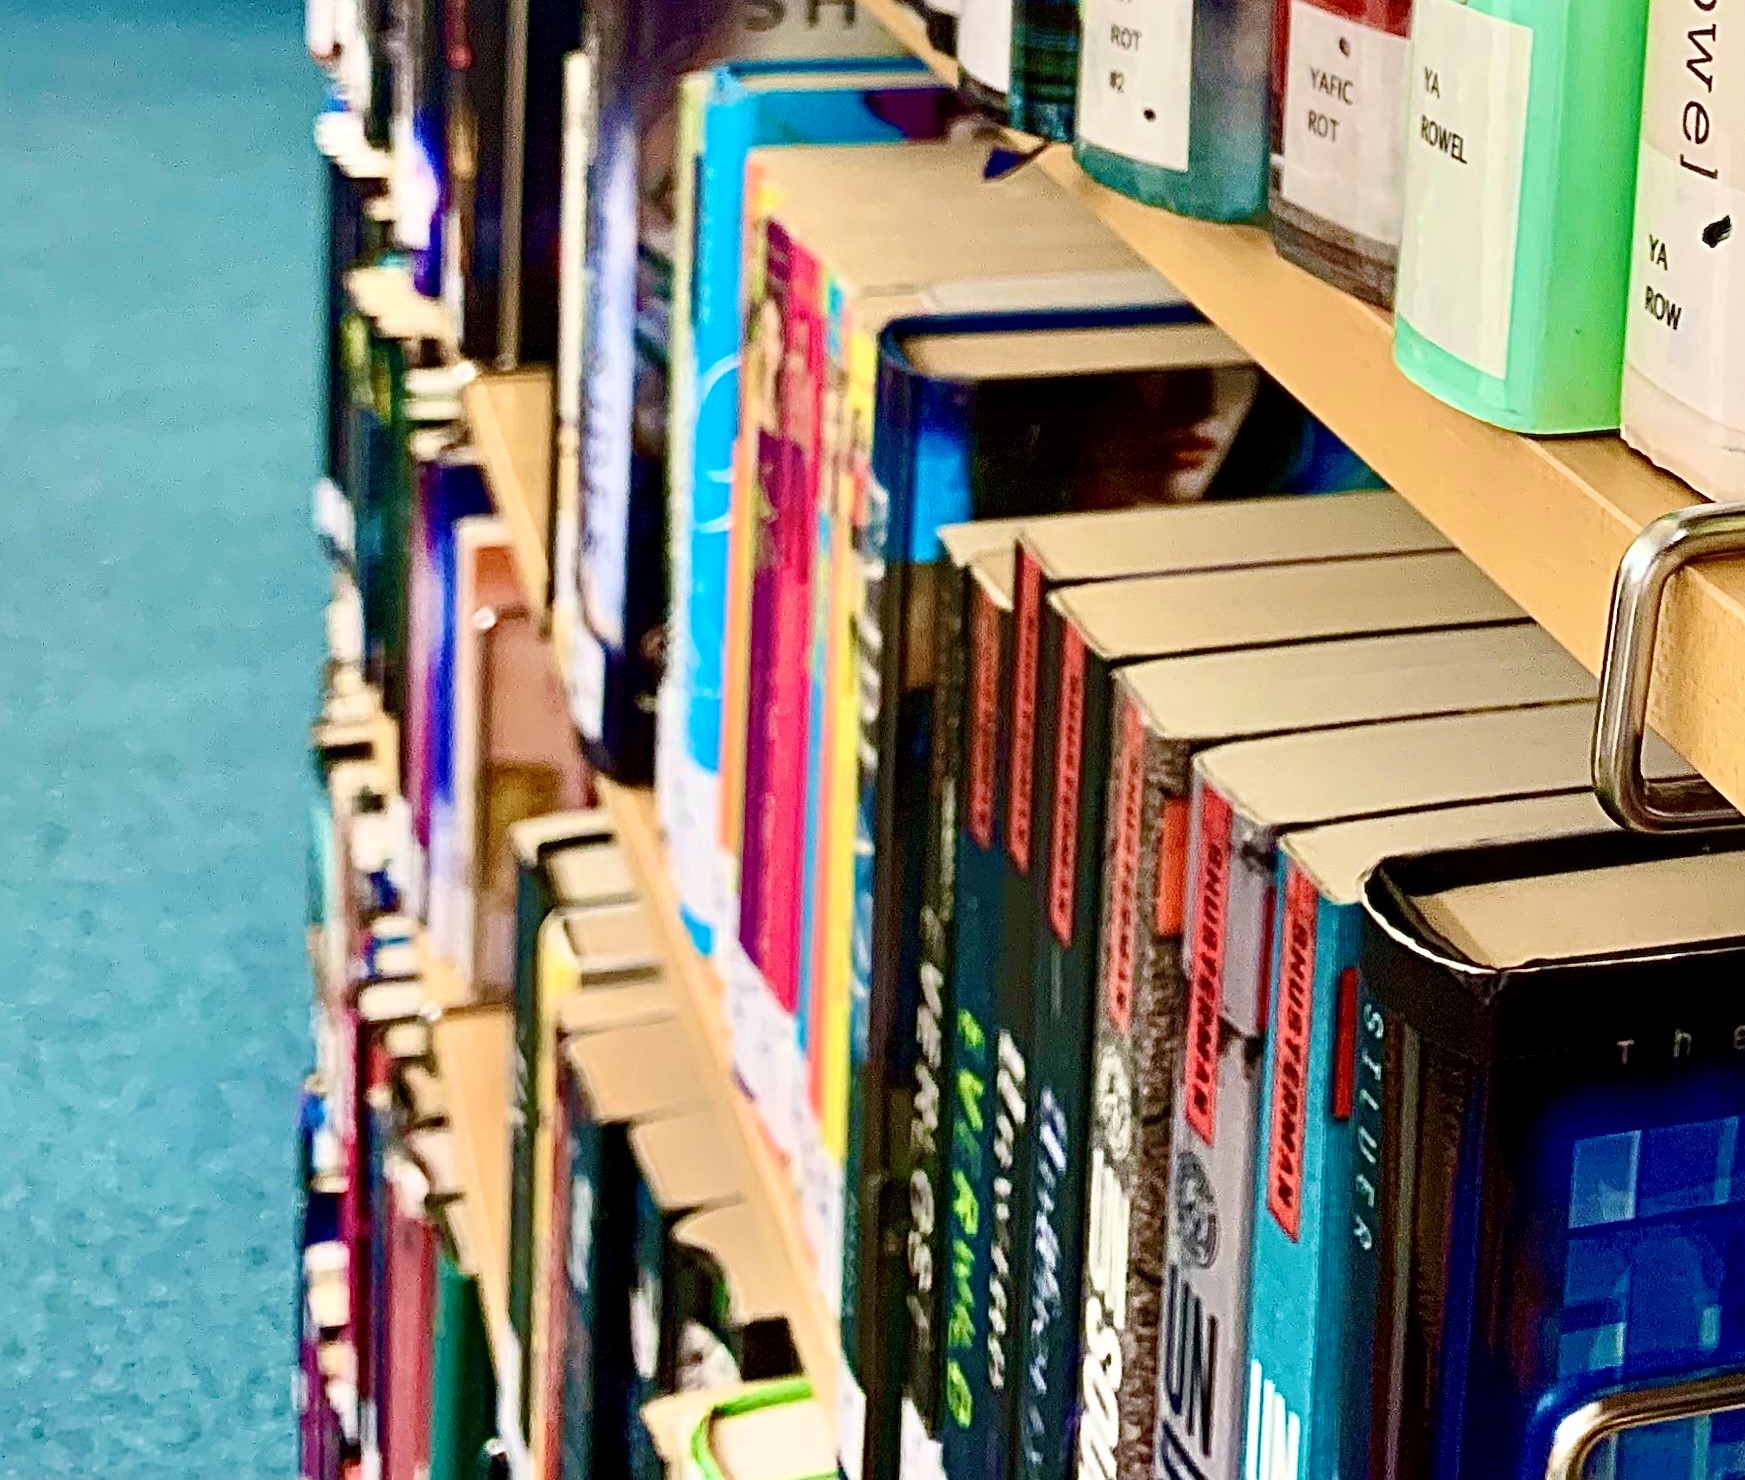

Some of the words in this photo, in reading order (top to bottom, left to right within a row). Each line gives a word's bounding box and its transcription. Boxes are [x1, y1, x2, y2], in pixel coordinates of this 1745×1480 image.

[1110, 23, 1142, 53] ROT
[1108, 70, 1126, 95] #2
[1309, 66, 1354, 106] YAFIC
[1424, 66, 1441, 99] YA
[1307, 108, 1340, 144] ROT
[1420, 114, 1469, 165] ROWEL
[1648, 233, 1668, 271] YA
[1644, 284, 1683, 331] ROW
[1354, 1001, 1386, 1252] SILVER
